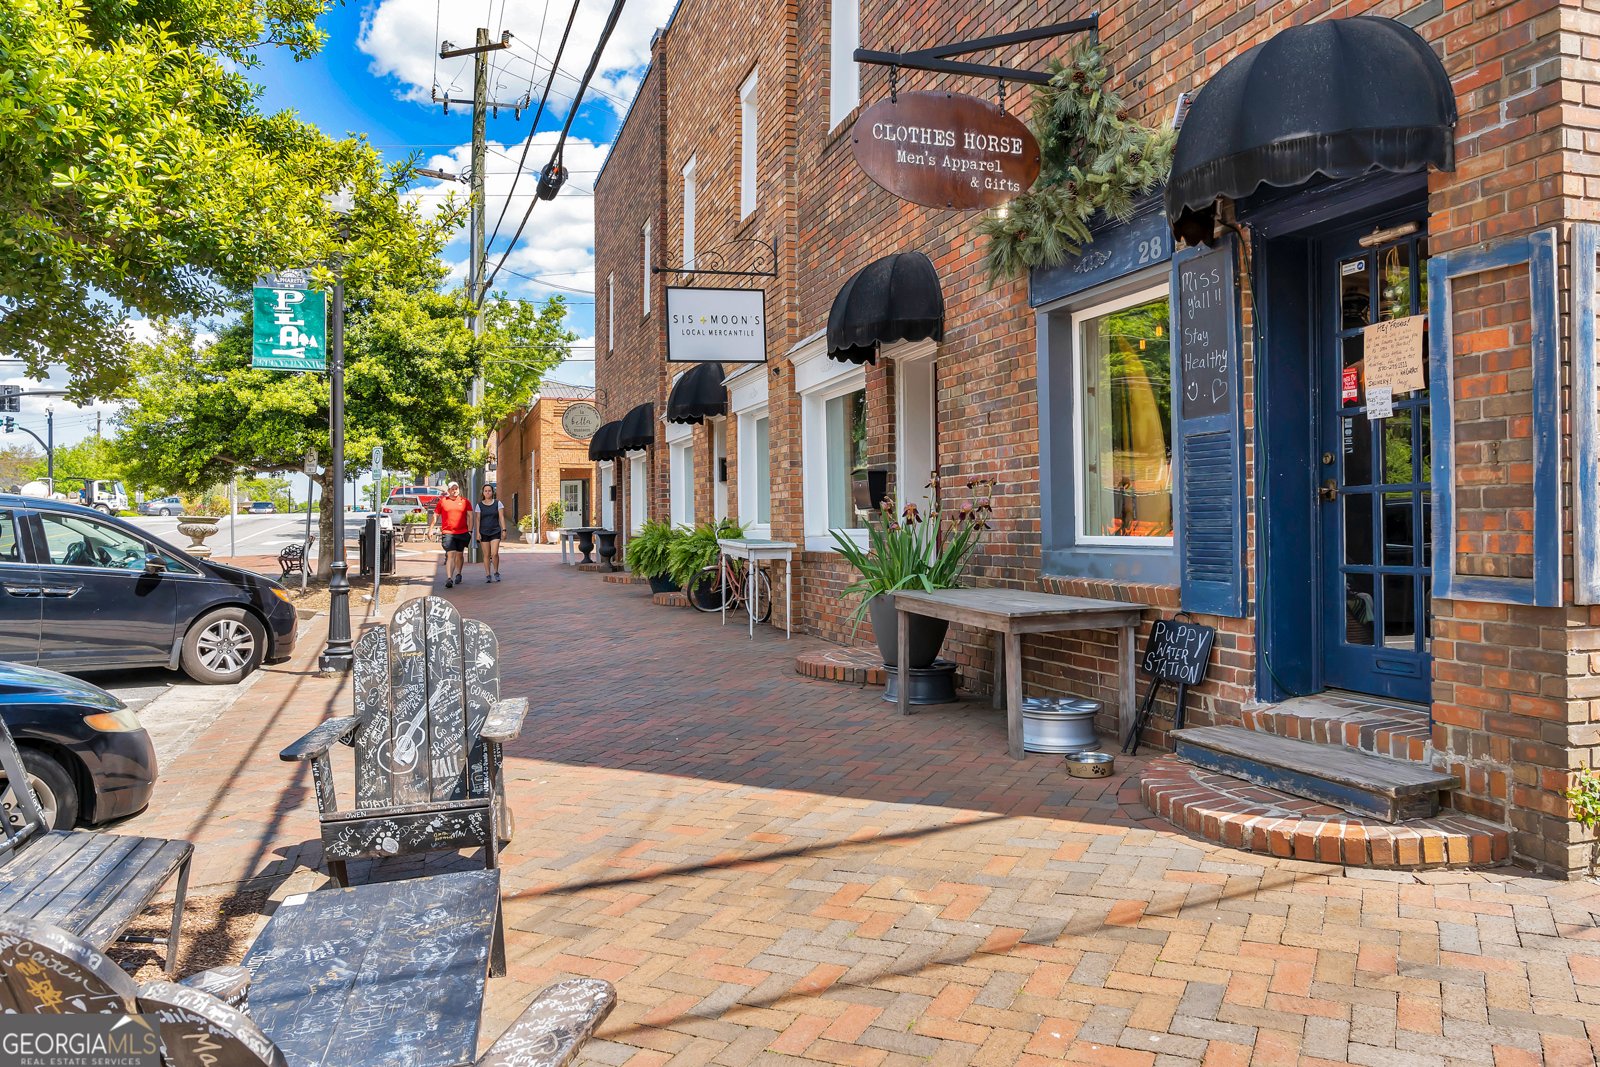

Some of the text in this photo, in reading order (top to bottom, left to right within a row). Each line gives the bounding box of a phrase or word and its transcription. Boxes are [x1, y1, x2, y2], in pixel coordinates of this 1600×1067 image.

[872, 122, 1023, 155] CLOTHES HORSE
[896, 149, 1003, 173] Men's Apparel
[970, 176, 1021, 192] & Gifts
[1138, 236, 1162, 264] 28
[1181, 268, 1220, 293] Miss
[272, 289, 306, 358] PLAY
[672, 314, 694, 324] SIS
[710, 314, 760, 325] MOON'S
[708, 329, 754, 337] MERCANTILE
[1184, 327, 1209, 347] Stay
[1184, 348, 1228, 373] Healthy
[395, 603, 420, 625] GABE
[1154, 621, 1210, 658] PUPPY
[1156, 642, 1189, 665] WATER
[1144, 651, 1200, 684] STATION
[434, 726, 448, 740] Go
[345, 811, 367, 819] OWEN
